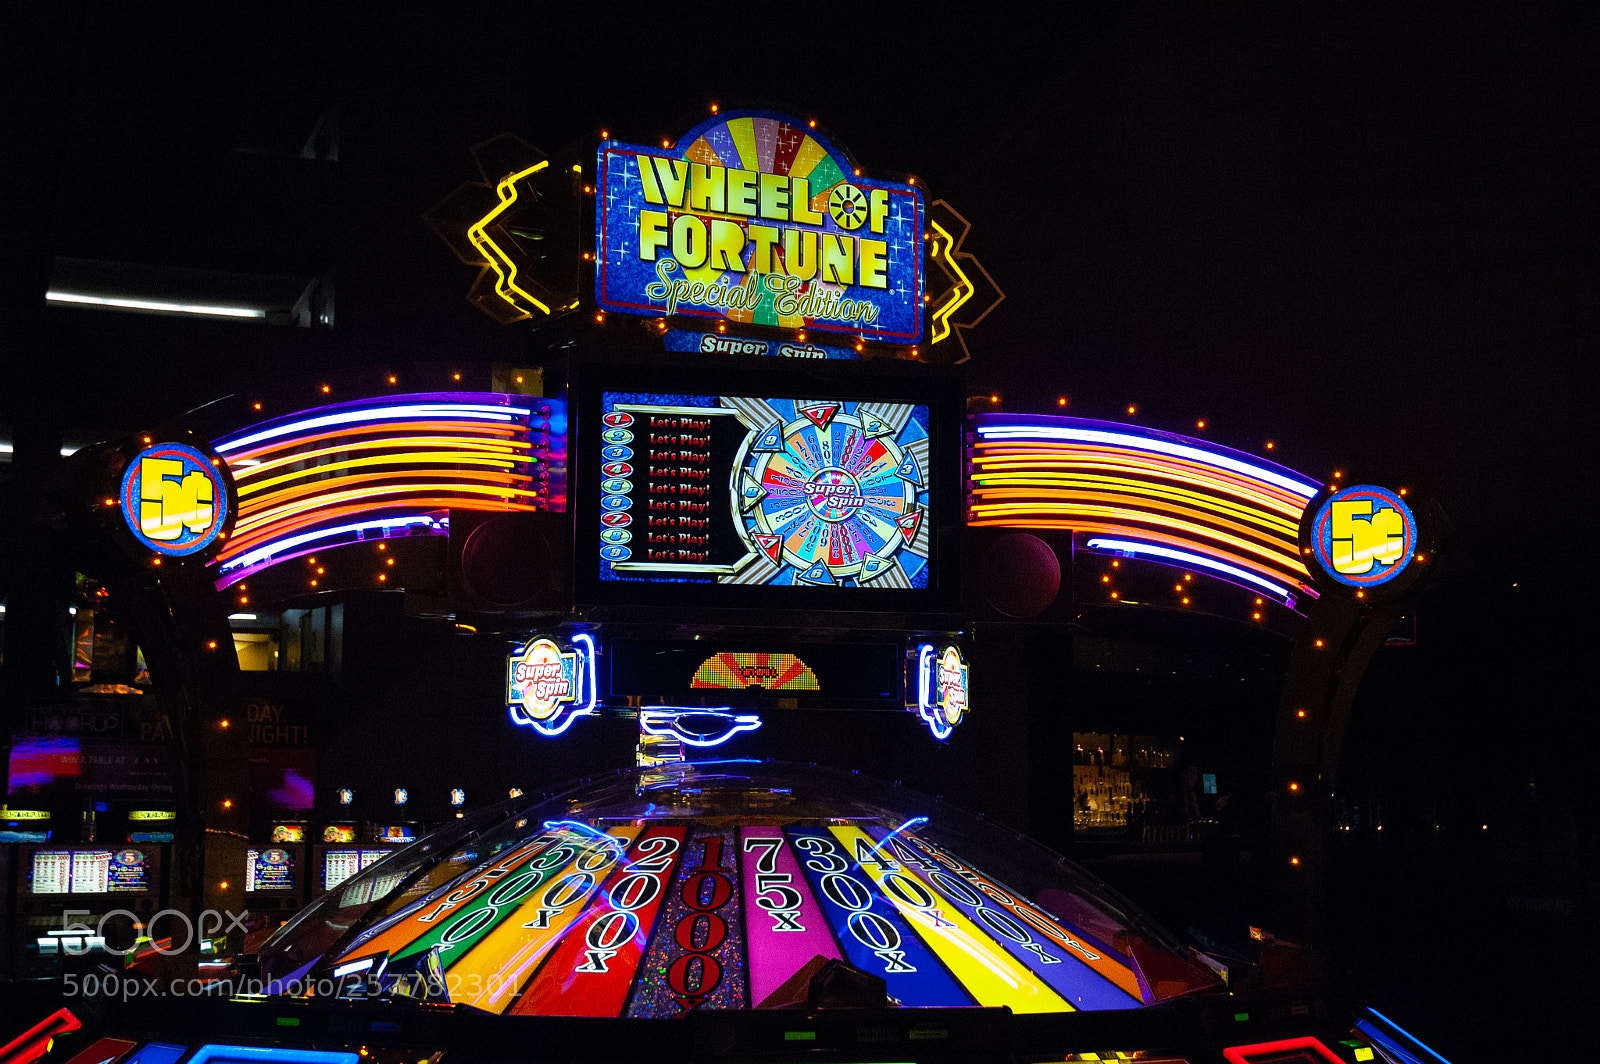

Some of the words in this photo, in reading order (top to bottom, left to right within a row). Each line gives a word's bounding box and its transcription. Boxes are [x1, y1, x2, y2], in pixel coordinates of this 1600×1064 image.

[636, 154, 824, 226] WHEEL
[639, 208, 888, 289] FORTUNE
[646, 258, 763, 316] Special
[764, 273, 880, 324] Edition
[701, 336, 767, 355] Super
[815, 408, 826, 419] 1
[614, 415, 623, 424] 1
[650, 417, 677, 428] Let's
[680, 418, 711, 431] Play!
[867, 421, 882, 432] 2
[611, 432, 624, 441] 2
[650, 434, 677, 445] Let's
[680, 434, 711, 447] Play!
[763, 435, 778, 446] 9
[611, 448, 623, 457] 3
[650, 450, 676, 461] Let's
[680, 451, 710, 463] Play!
[610, 465, 623, 474] 4
[649, 466, 676, 477] Let's
[680, 467, 710, 480] Play!
[900, 464, 914, 474] 3
[610, 481, 623, 490] 5
[649, 483, 676, 494] Let's
[679, 484, 710, 496] Play!
[744, 486, 759, 498] 8
[804, 482, 855, 496] Super
[610, 498, 622, 507] 6
[649, 499, 675, 510] Let's
[679, 501, 709, 513] Play!
[828, 495, 865, 509] Spin
[609, 515, 624, 524] 7
[649, 516, 675, 527] Let's
[679, 517, 709, 530] Play!
[900, 518, 915, 529] 4
[610, 531, 623, 540] 8
[648, 533, 675, 544] Let's
[679, 533, 709, 546] Play!
[763, 537, 780, 549] 7
[610, 548, 622, 557] 9
[648, 549, 675, 560] Let's
[679, 550, 709, 563] Play!
[865, 560, 881, 571] 5
[810, 568, 824, 579] 6
[516, 663, 561, 682] Super
[536, 679, 569, 701] Spin
